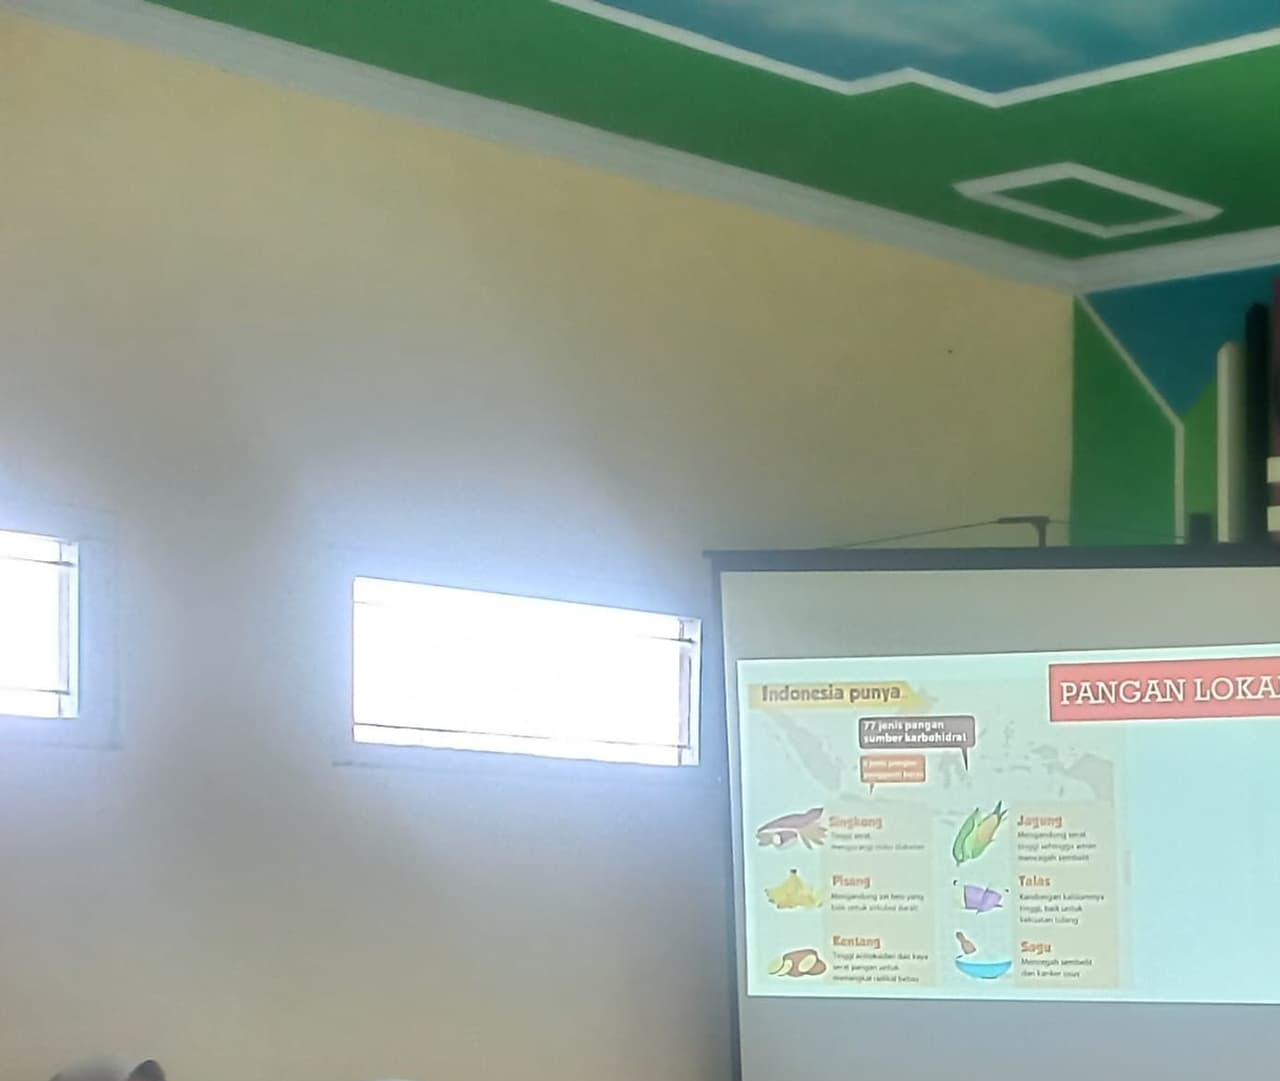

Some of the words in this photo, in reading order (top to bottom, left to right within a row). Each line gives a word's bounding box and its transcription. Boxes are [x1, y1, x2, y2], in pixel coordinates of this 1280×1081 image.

[762, 684, 844, 701] Indonesia
[1060, 679, 1186, 705] PANGAN
[864, 721, 876, 730] 77
[879, 720, 902, 731] jenis
[905, 721, 944, 731] pangan
[864, 733, 903, 743] sumber
[905, 732, 967, 742] karbohidrat
[1017, 814, 1062, 829] Jagung
[832, 874, 871, 889] Pisang
[1018, 874, 1051, 887] Talas
[832, 935, 881, 949] Kentang
[1020, 940, 1052, 955] Sagu
